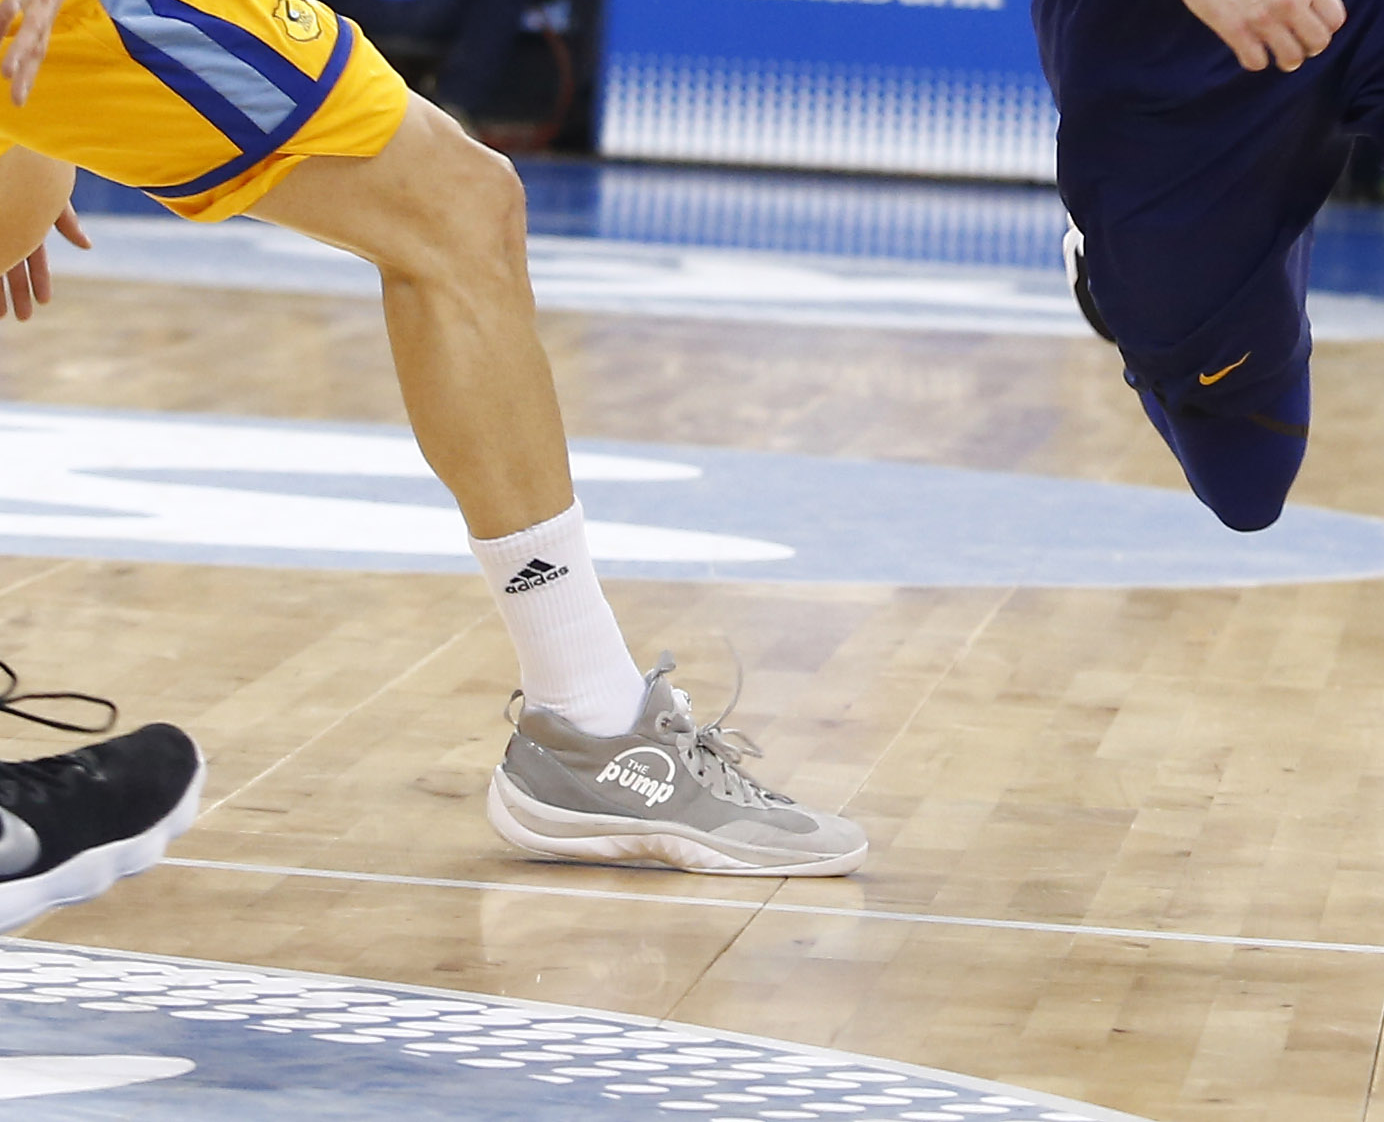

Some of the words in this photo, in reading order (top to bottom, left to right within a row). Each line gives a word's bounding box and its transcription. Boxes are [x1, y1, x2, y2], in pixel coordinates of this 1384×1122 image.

[505, 566, 569, 594] adidas
[627, 758, 650, 775] THE
[595, 761, 675, 808] pump
